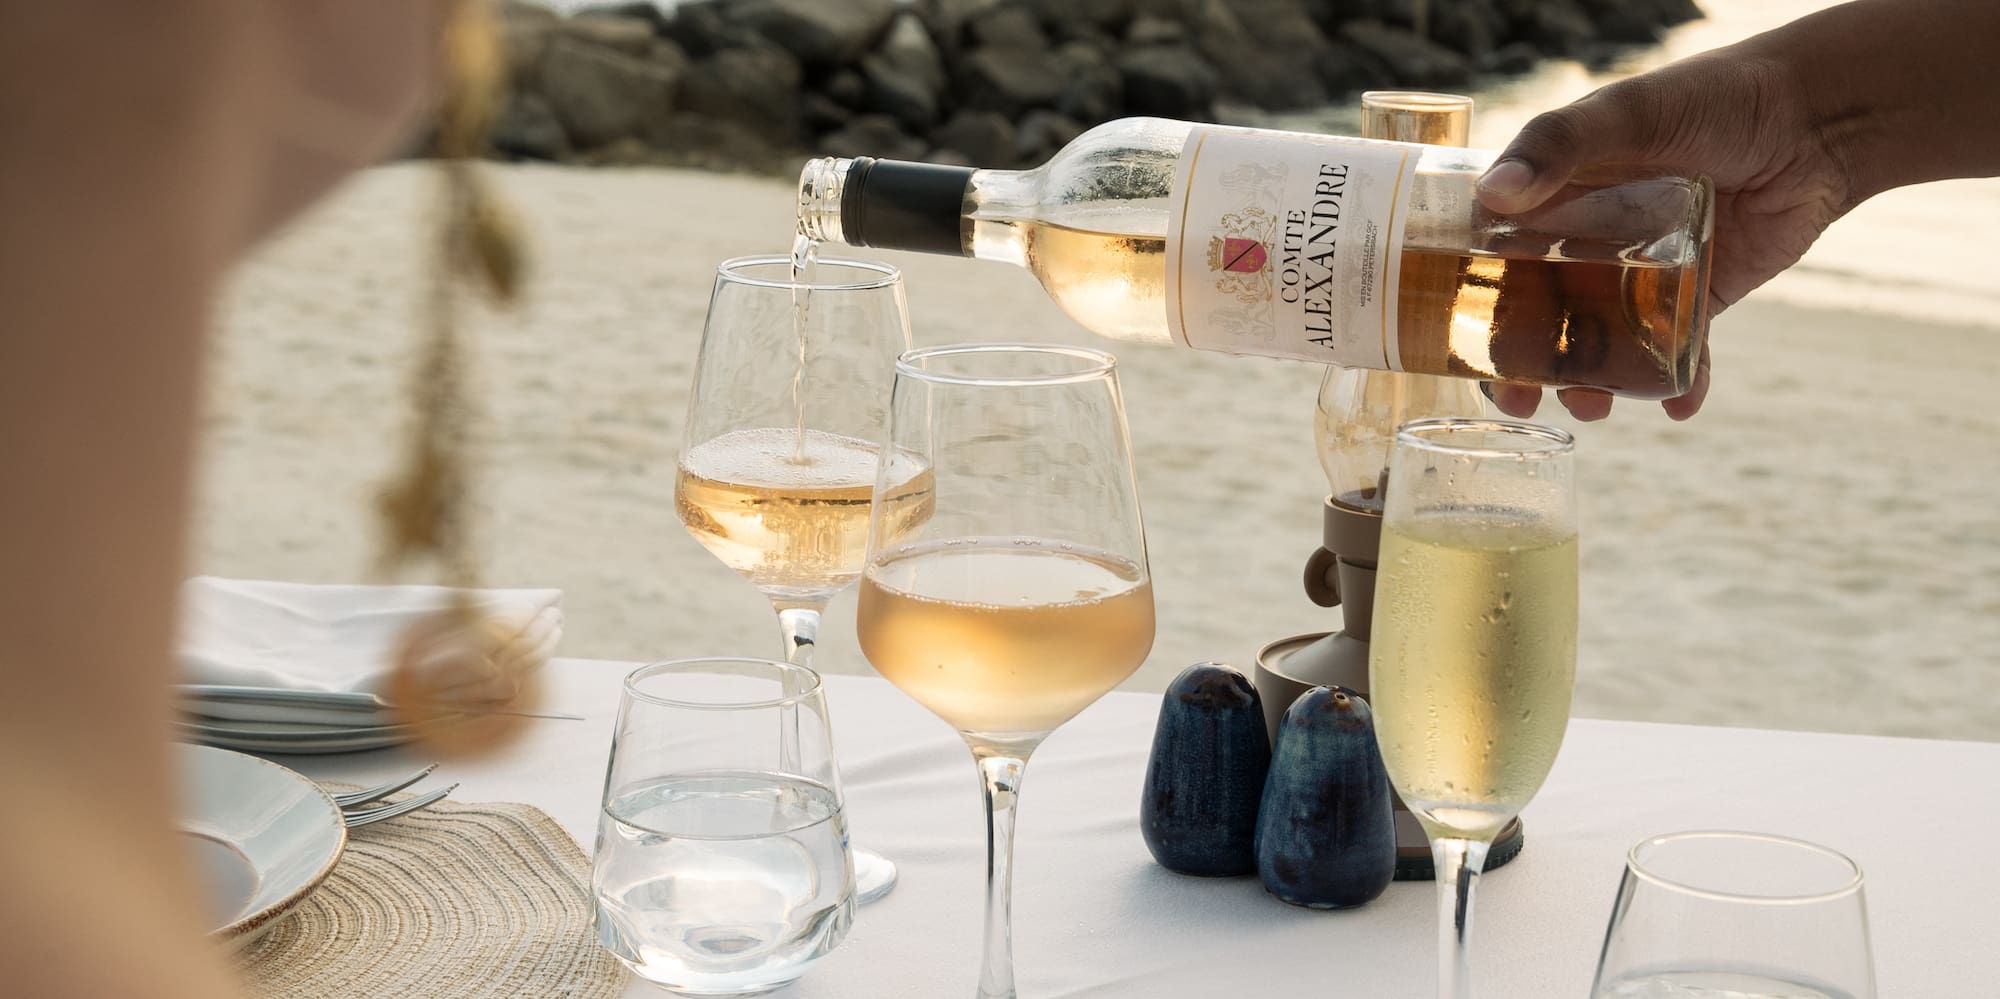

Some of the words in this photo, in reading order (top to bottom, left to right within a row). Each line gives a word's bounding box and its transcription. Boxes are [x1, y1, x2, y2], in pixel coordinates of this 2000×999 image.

[1281, 209, 1306, 303] COMTE
[1304, 164, 1349, 350] ALEXANDRE
[1361, 248, 1369, 285] BOUTEILLE
